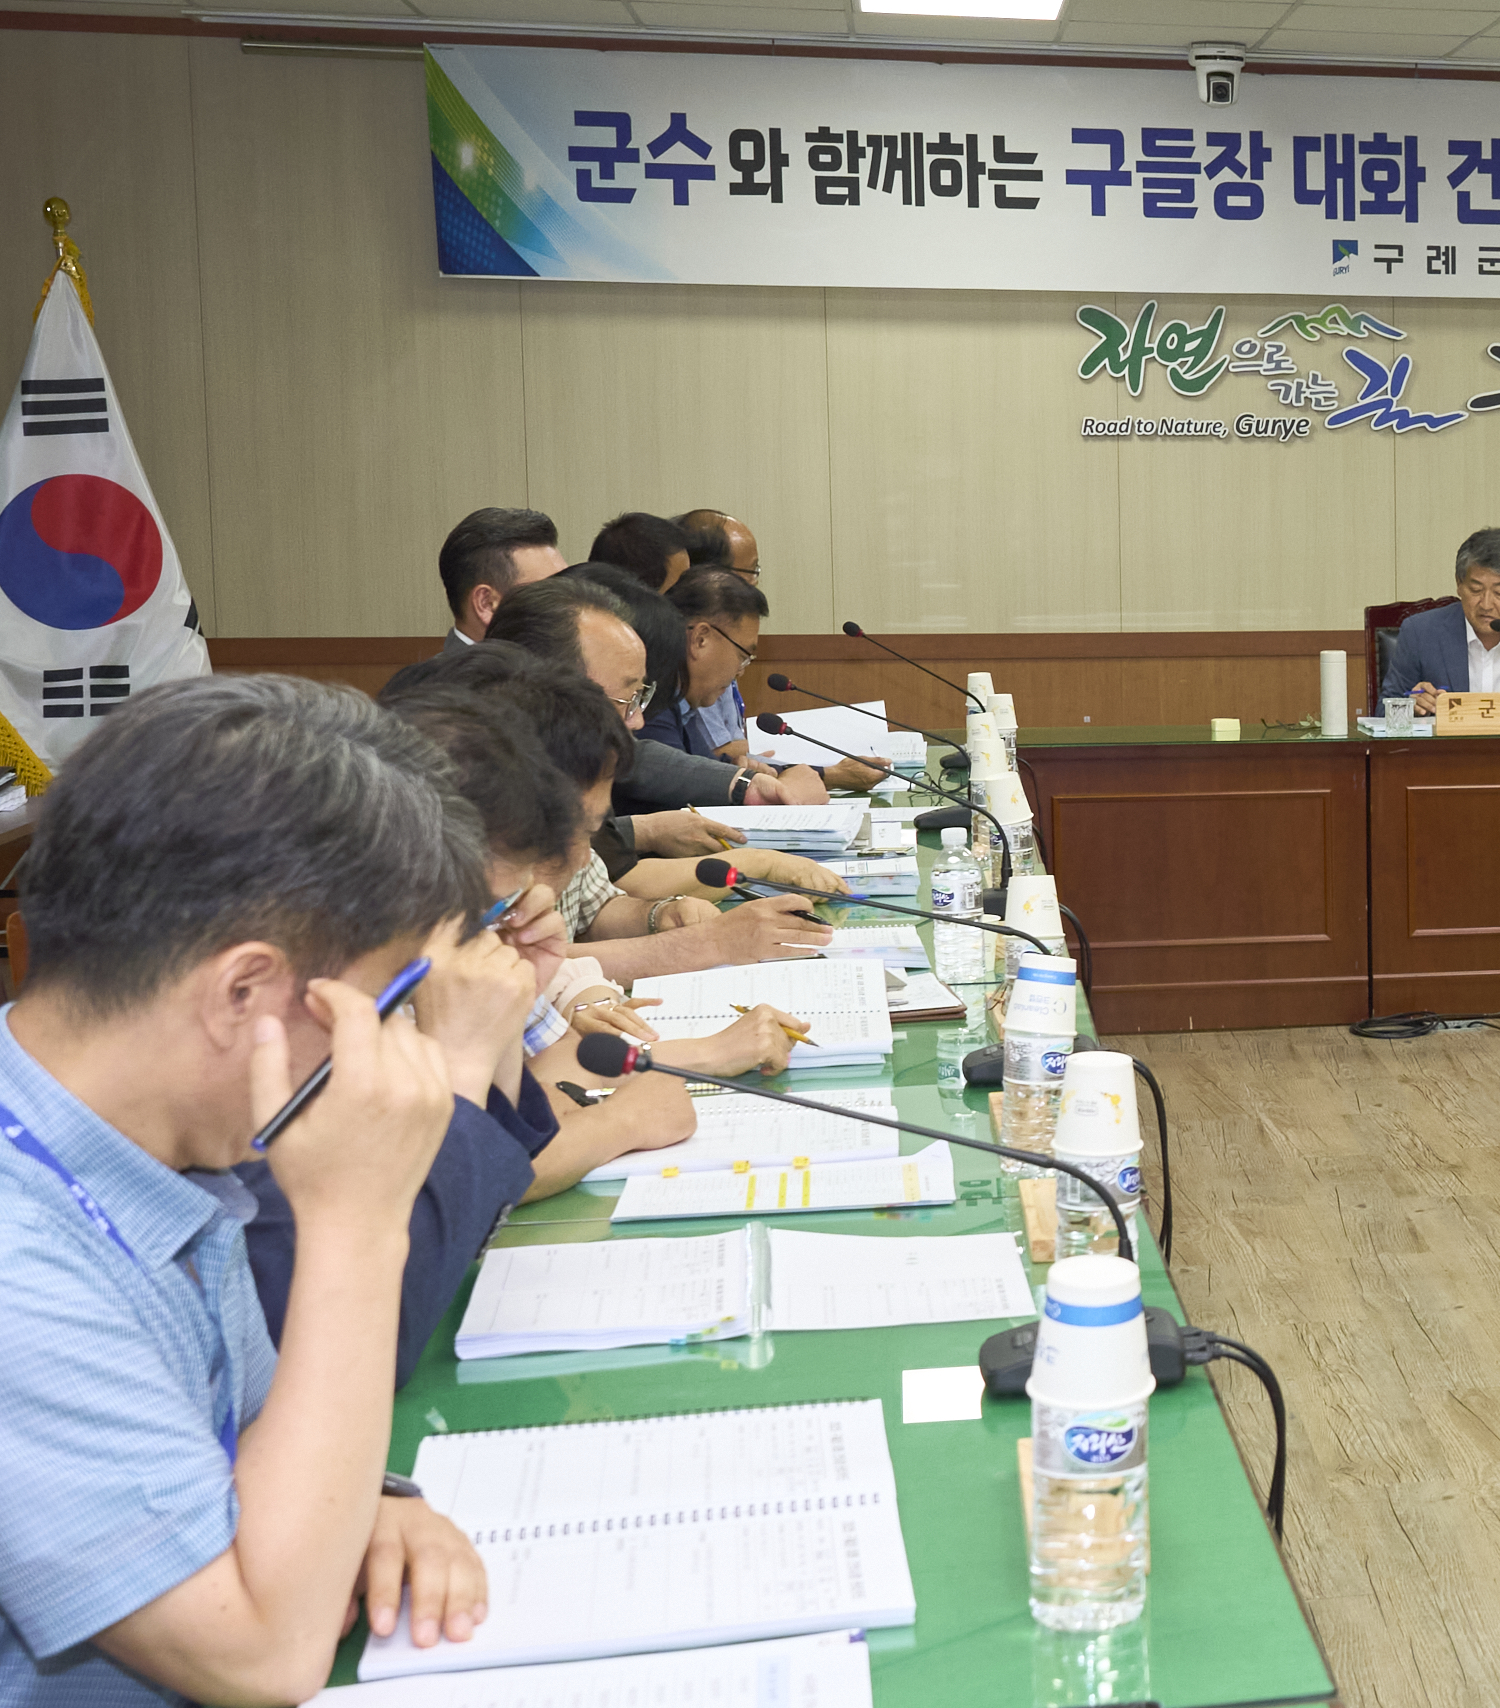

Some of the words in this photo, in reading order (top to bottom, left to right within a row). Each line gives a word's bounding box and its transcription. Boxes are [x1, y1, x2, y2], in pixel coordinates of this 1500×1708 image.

[804, 126, 1044, 210] 함께하는
[1065, 127, 1273, 221] 구들장
[1292, 132, 1427, 224] 대화
[1269, 374, 1338, 409] 가는
[1327, 349, 1466, 431] 길
[1082, 417, 1132, 435] Road
[1136, 418, 1155, 435] to
[1158, 418, 1229, 438] Nature,
[1234, 413, 1310, 441] Gurye
[1070, 1430, 1134, 1456] 지리산
